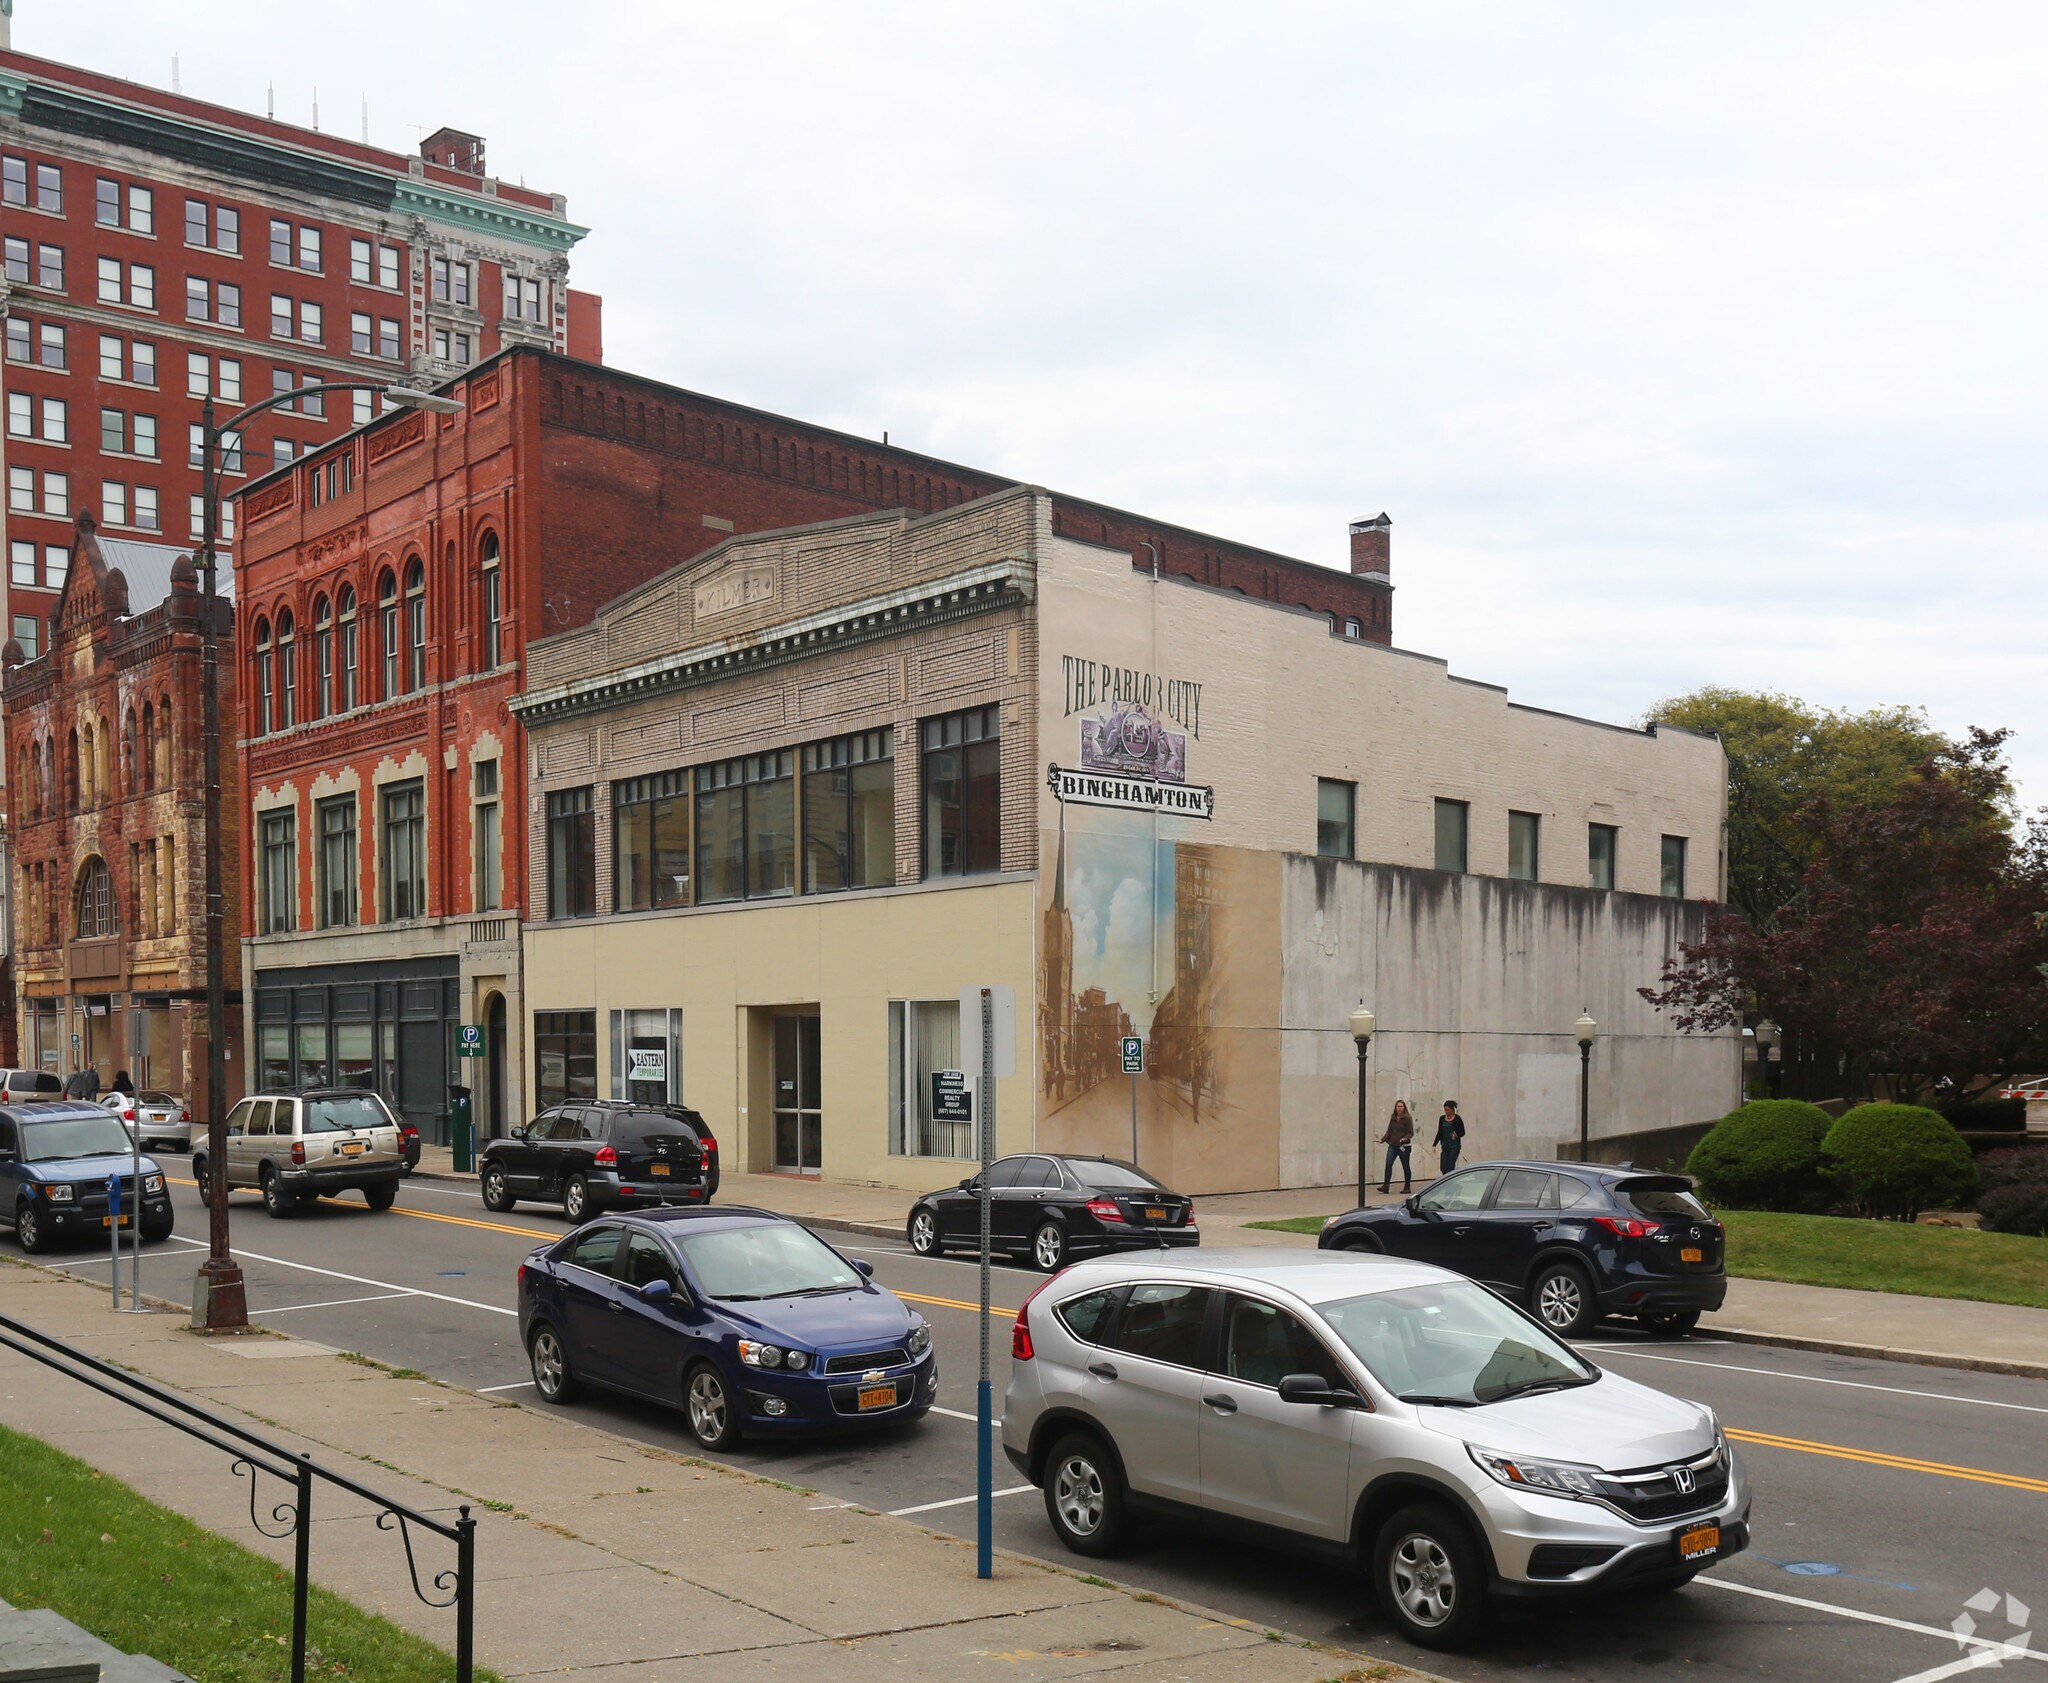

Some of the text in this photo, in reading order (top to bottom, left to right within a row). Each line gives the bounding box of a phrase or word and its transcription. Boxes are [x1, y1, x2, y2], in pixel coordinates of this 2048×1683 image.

[706, 577, 761, 611] KILMER
[1062, 654, 1203, 742] THE PARLOR CITY
[1062, 776, 1203, 811] BINGHAMTON
[467, 1028, 475, 1041] P
[1128, 1043, 1136, 1054] P
[636, 1053, 664, 1067] EASTERN
[1685, 1546, 1717, 1561] MILLER
